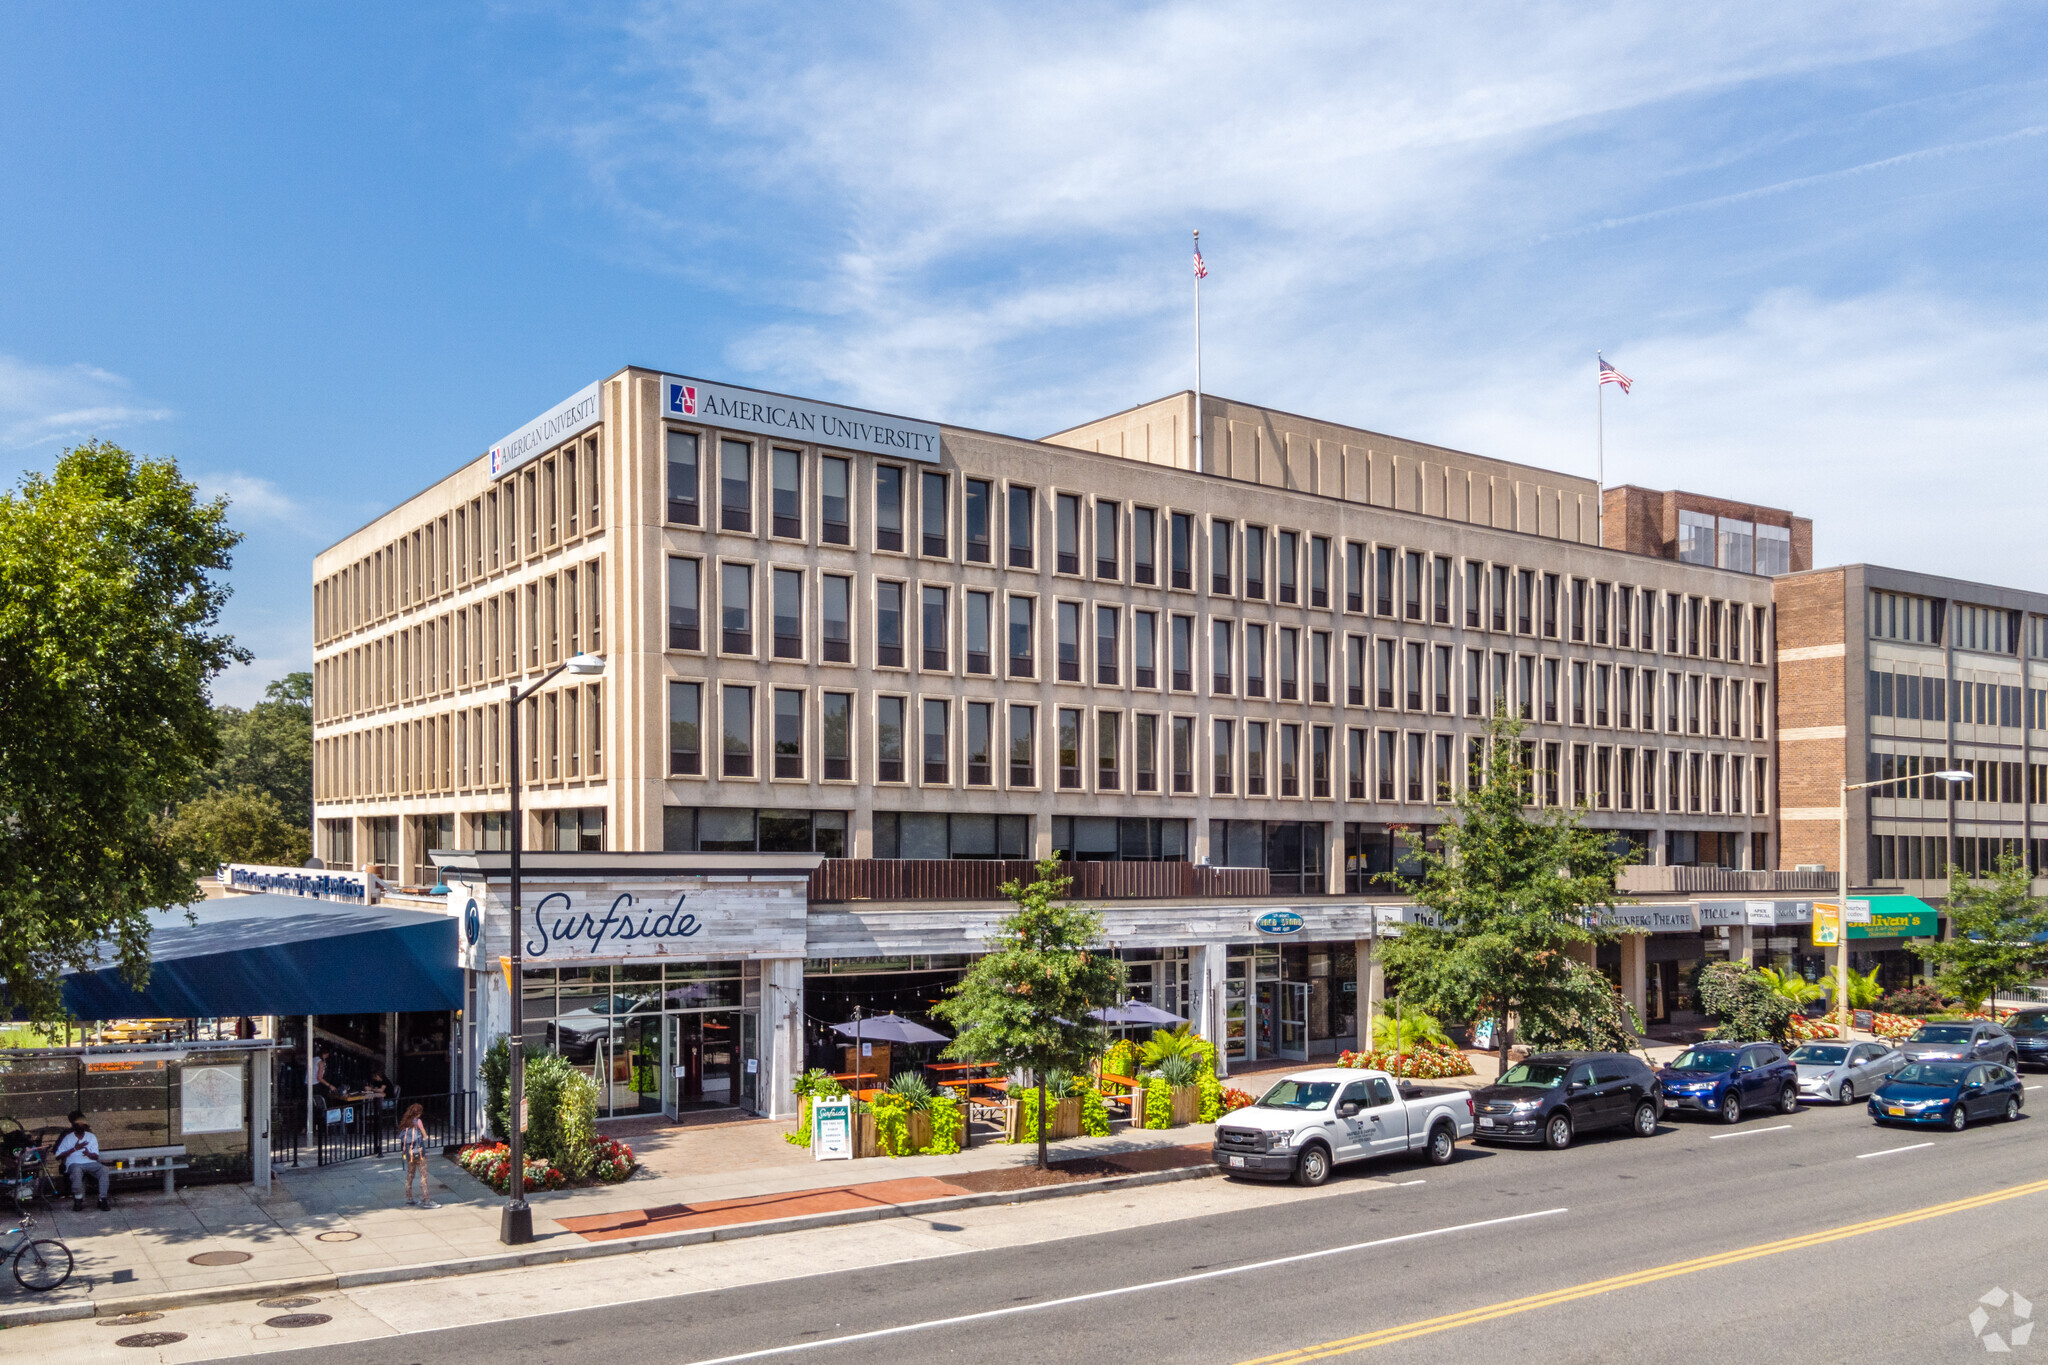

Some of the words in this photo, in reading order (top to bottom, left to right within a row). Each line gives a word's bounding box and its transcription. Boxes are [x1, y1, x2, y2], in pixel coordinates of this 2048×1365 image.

[501, 422, 542, 466] AMERICAN
[543, 394, 596, 442] UNIVERSITY
[703, 394, 816, 433] AMERICAN
[821, 415, 936, 453] UNIVERSITY
[526, 892, 702, 957] Surfside
[1414, 912, 1434, 926] The
[1653, 912, 1690, 926] THEATRE
[1848, 913, 1921, 928] ulivan's
[818, 1107, 847, 1119] Surfside
